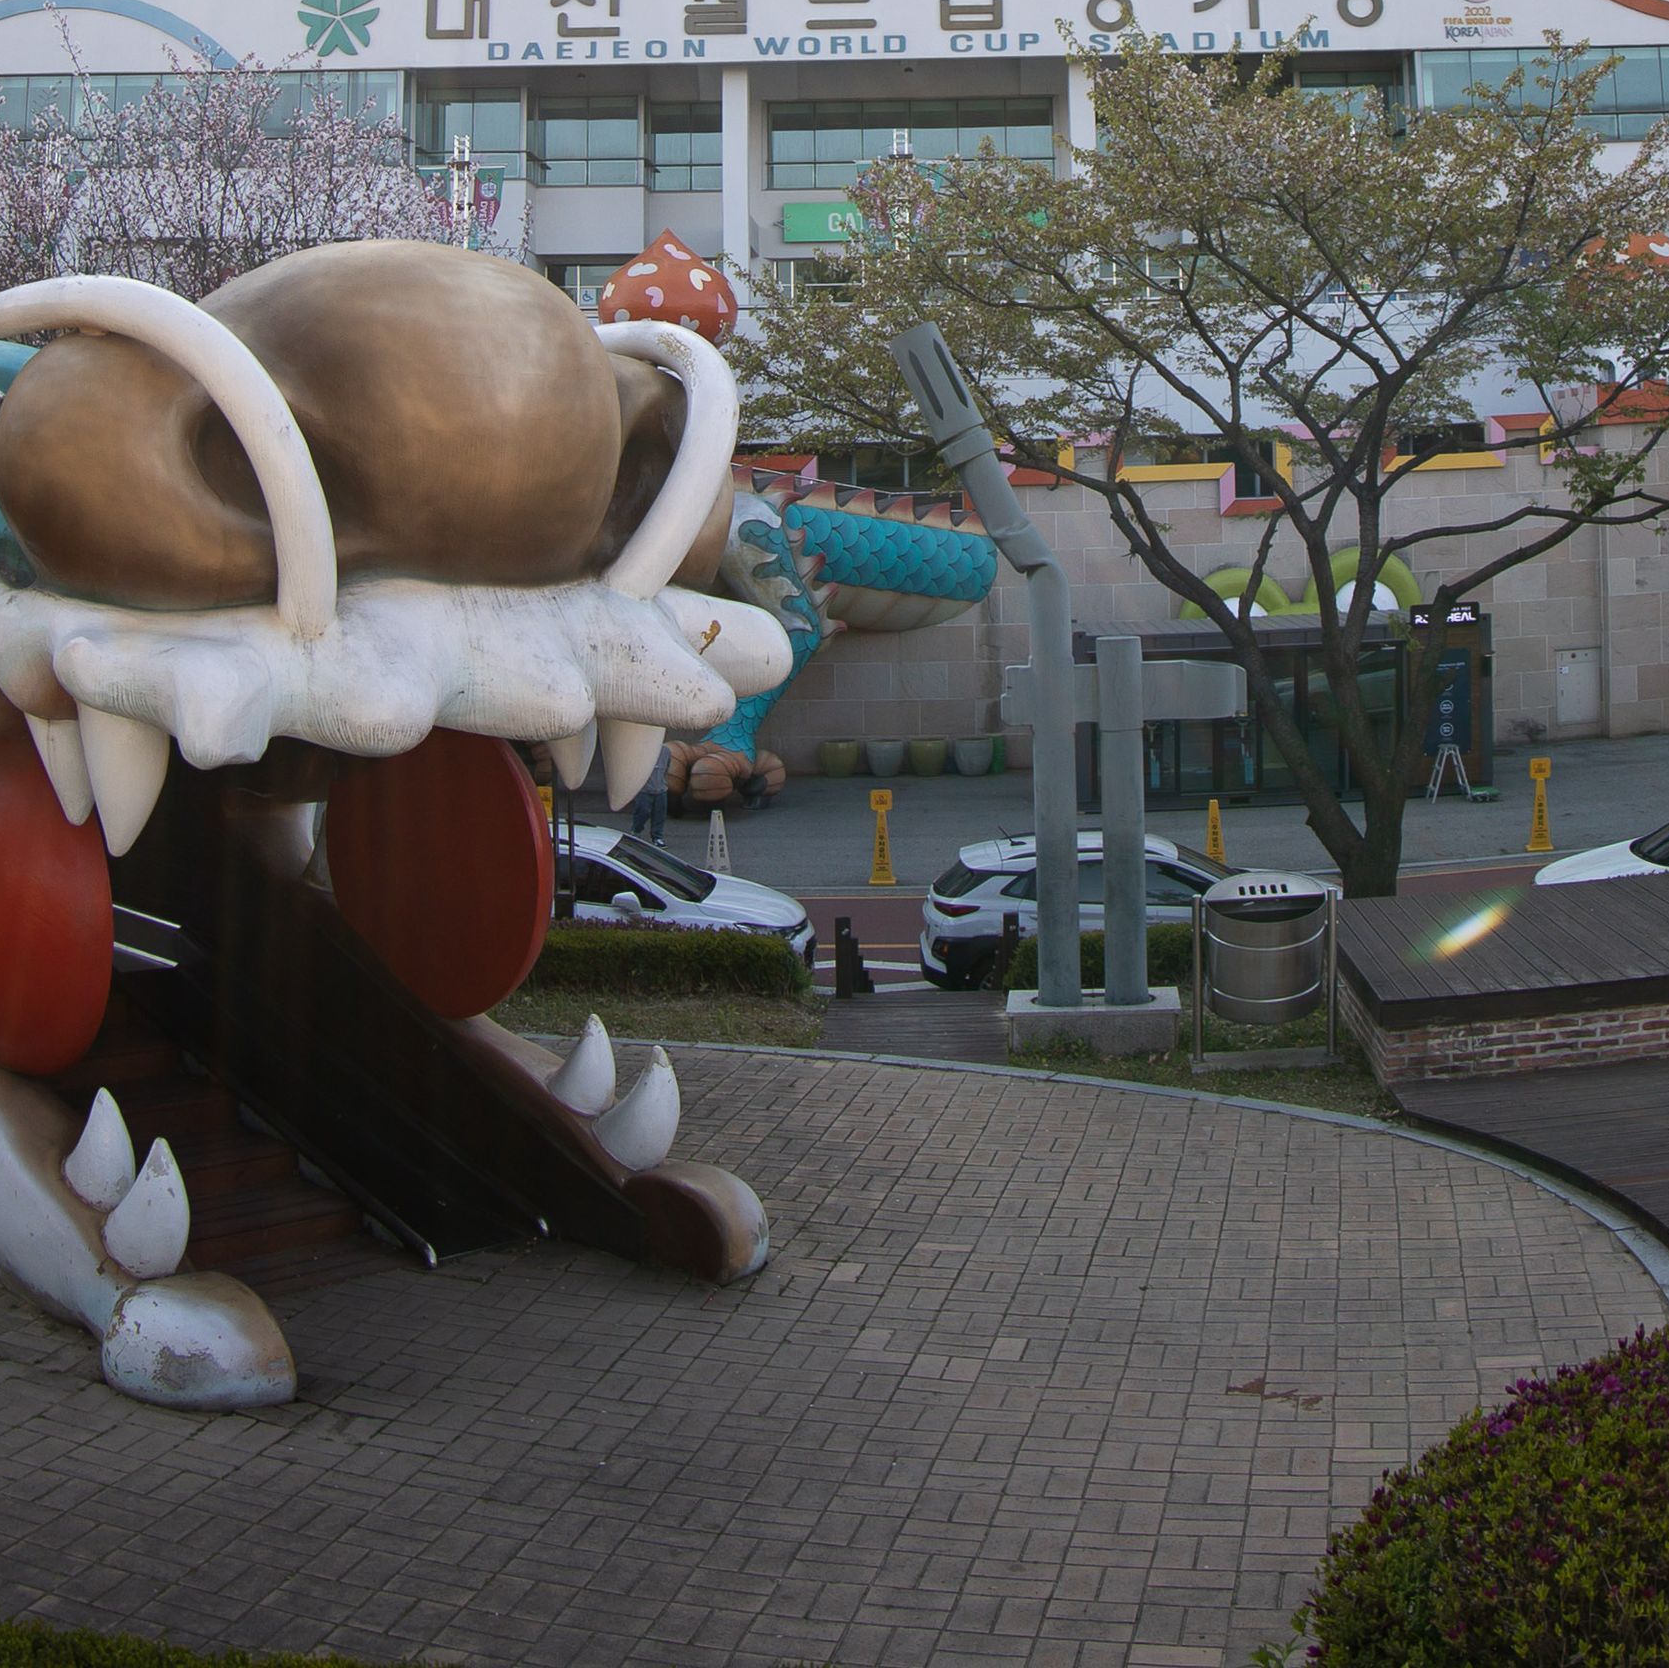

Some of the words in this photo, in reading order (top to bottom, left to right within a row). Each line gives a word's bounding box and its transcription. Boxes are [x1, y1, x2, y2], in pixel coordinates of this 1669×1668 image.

[1464, 6, 1492, 16] 2002
[1466, 17, 1495, 25] WORLD
[1496, 17, 1513, 25] CUP
[487, 38, 706, 61] DAEJEON
[753, 34, 907, 55] WORLD
[950, 33, 1040, 52] CUP
